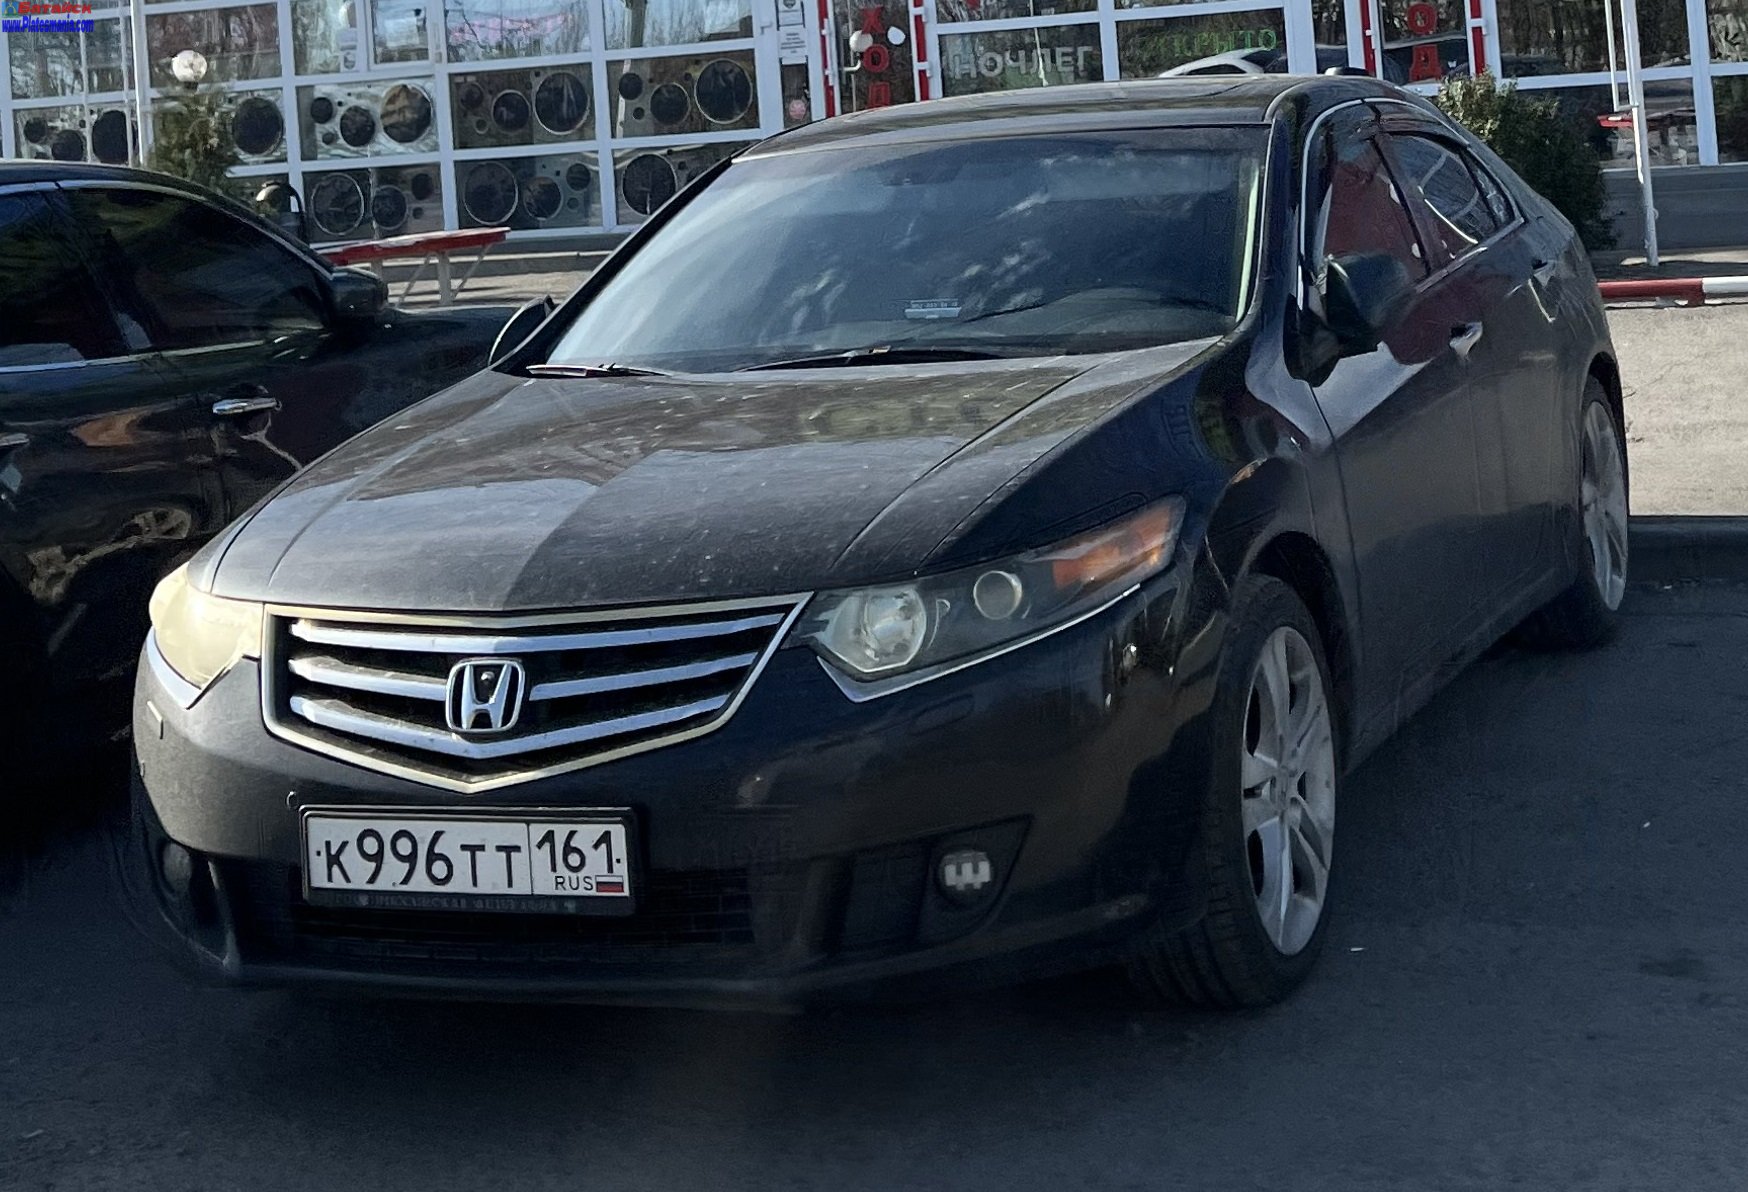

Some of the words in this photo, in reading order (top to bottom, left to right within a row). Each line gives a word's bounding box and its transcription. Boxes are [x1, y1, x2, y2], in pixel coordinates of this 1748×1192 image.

[1136, 29, 1277, 58] КРЫТО
[952, 45, 1093, 79] НОЧЛЕГ
[324, 828, 522, 888] К996ТТ
[535, 829, 615, 874] 161
[554, 875, 594, 891] RUS
